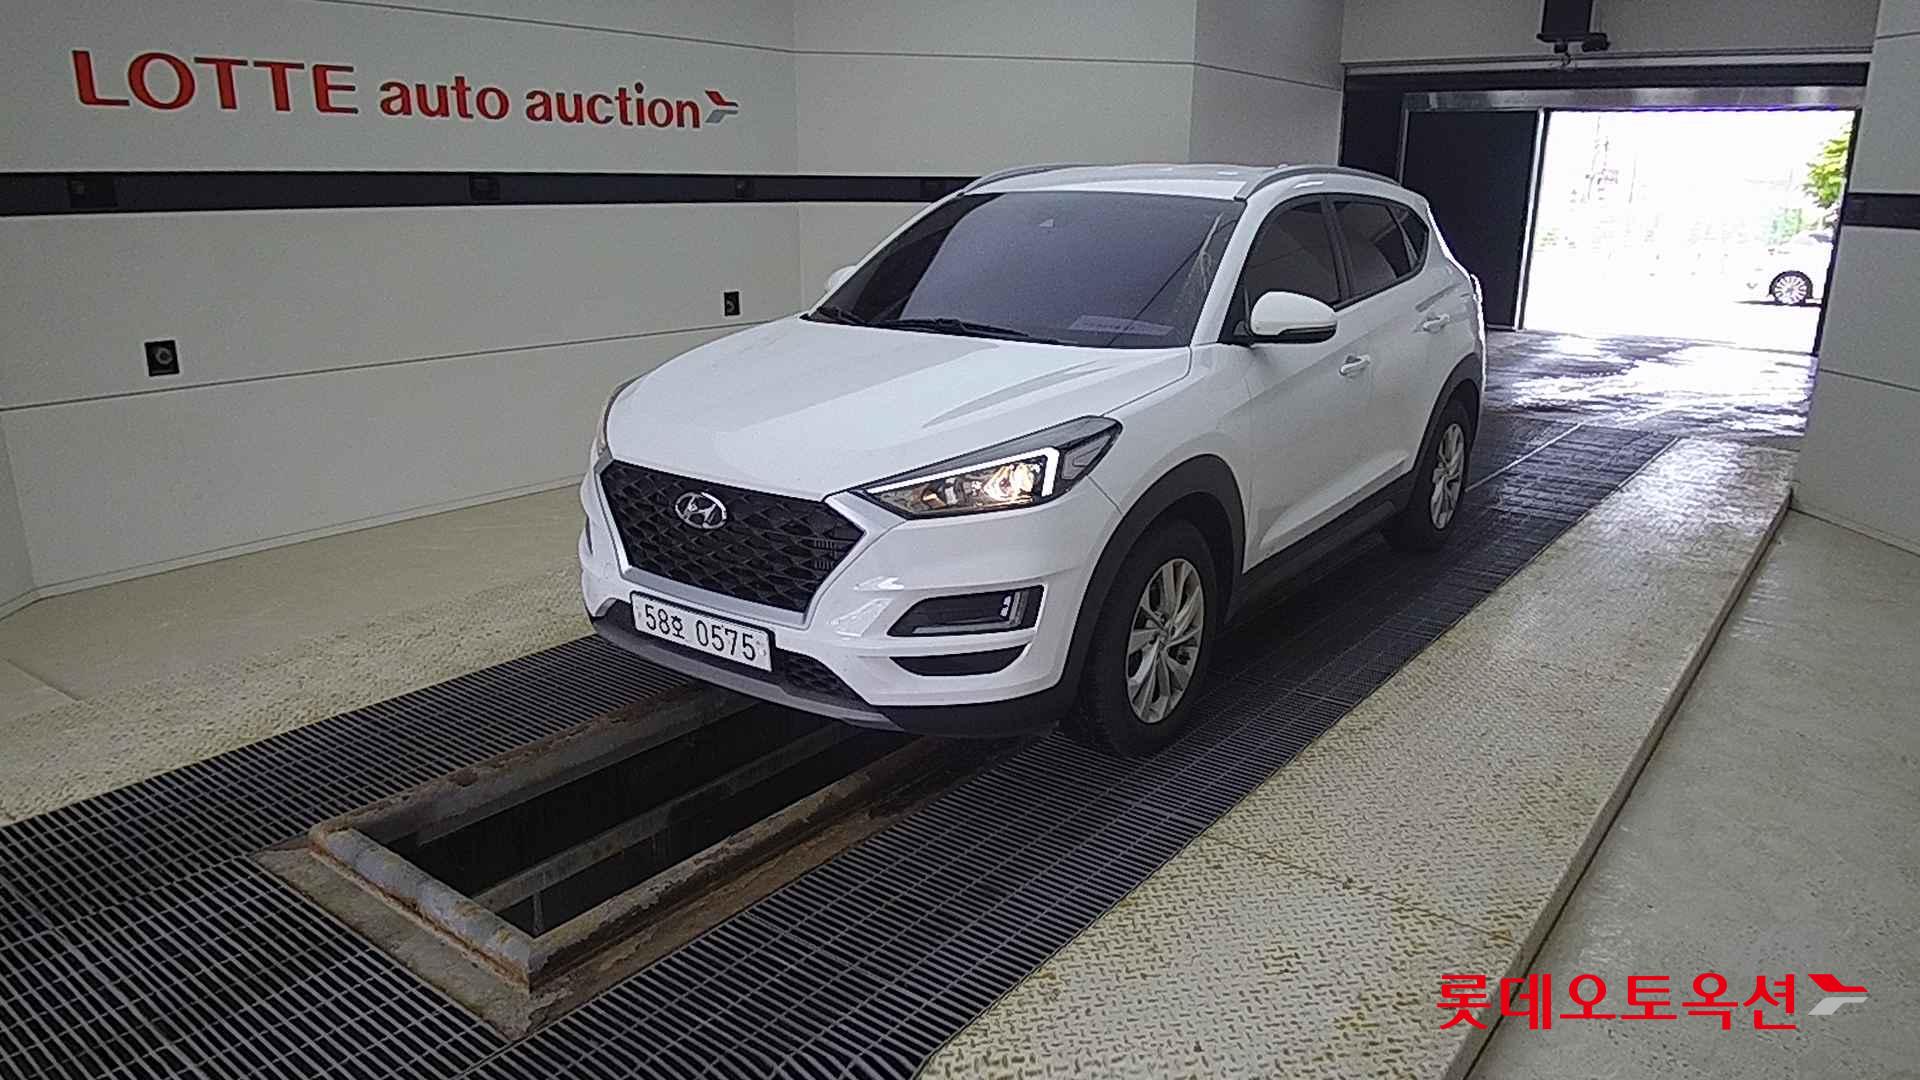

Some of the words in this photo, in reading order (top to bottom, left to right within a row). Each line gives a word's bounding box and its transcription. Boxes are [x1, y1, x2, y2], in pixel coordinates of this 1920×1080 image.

[72, 50, 359, 115] LOTTE
[379, 76, 510, 122] auto
[525, 82, 701, 129] auction
[645, 604, 685, 640] 58호
[696, 620, 756, 662] 0575
